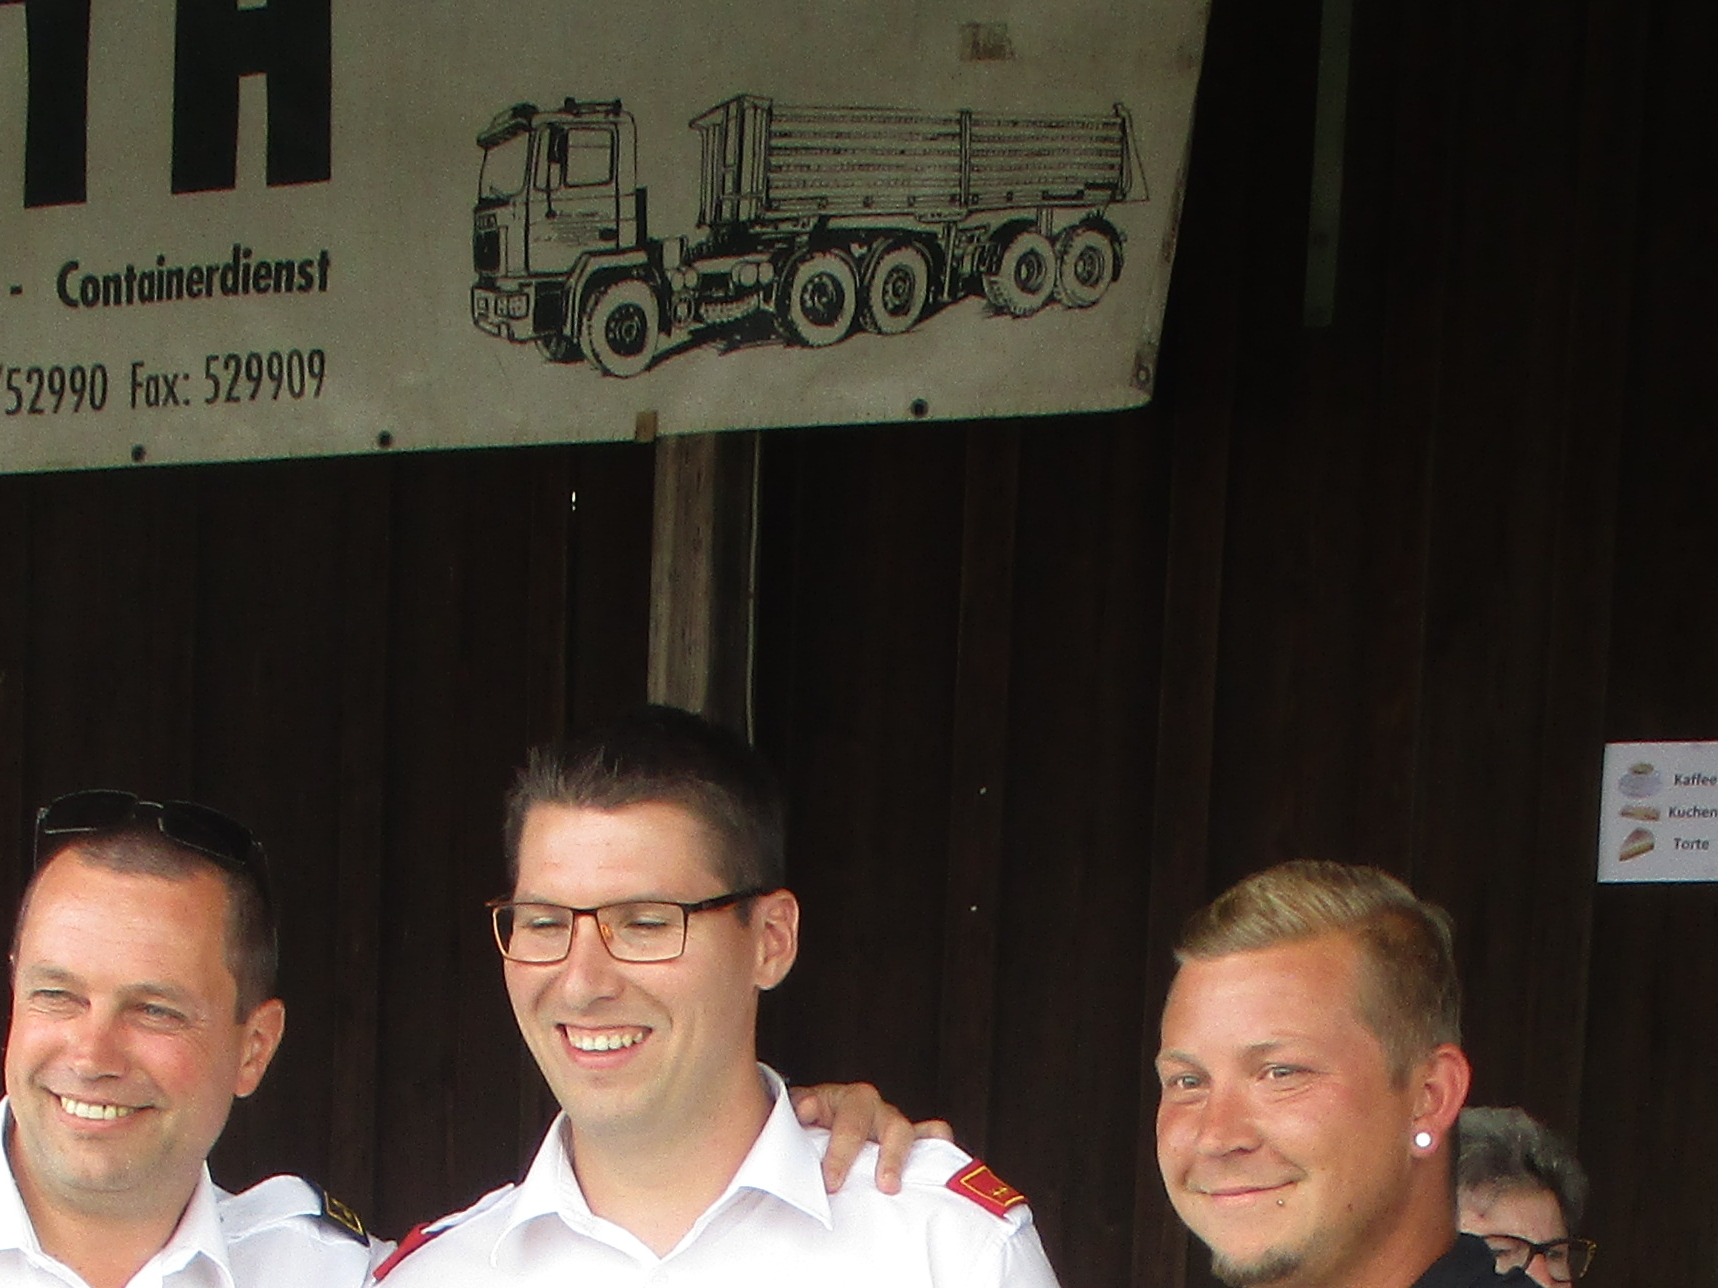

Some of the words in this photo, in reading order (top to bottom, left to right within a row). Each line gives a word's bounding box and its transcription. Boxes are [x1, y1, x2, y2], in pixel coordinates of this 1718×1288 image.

[56, 244, 331, 310] Containerdienst
[130, 360, 190, 410] Fax:
[204, 348, 327, 404] 529909
[1673, 772, 1718, 787] Kaffee
[1667, 804, 1718, 819] Kuchen
[1673, 836, 1711, 851] Torte
